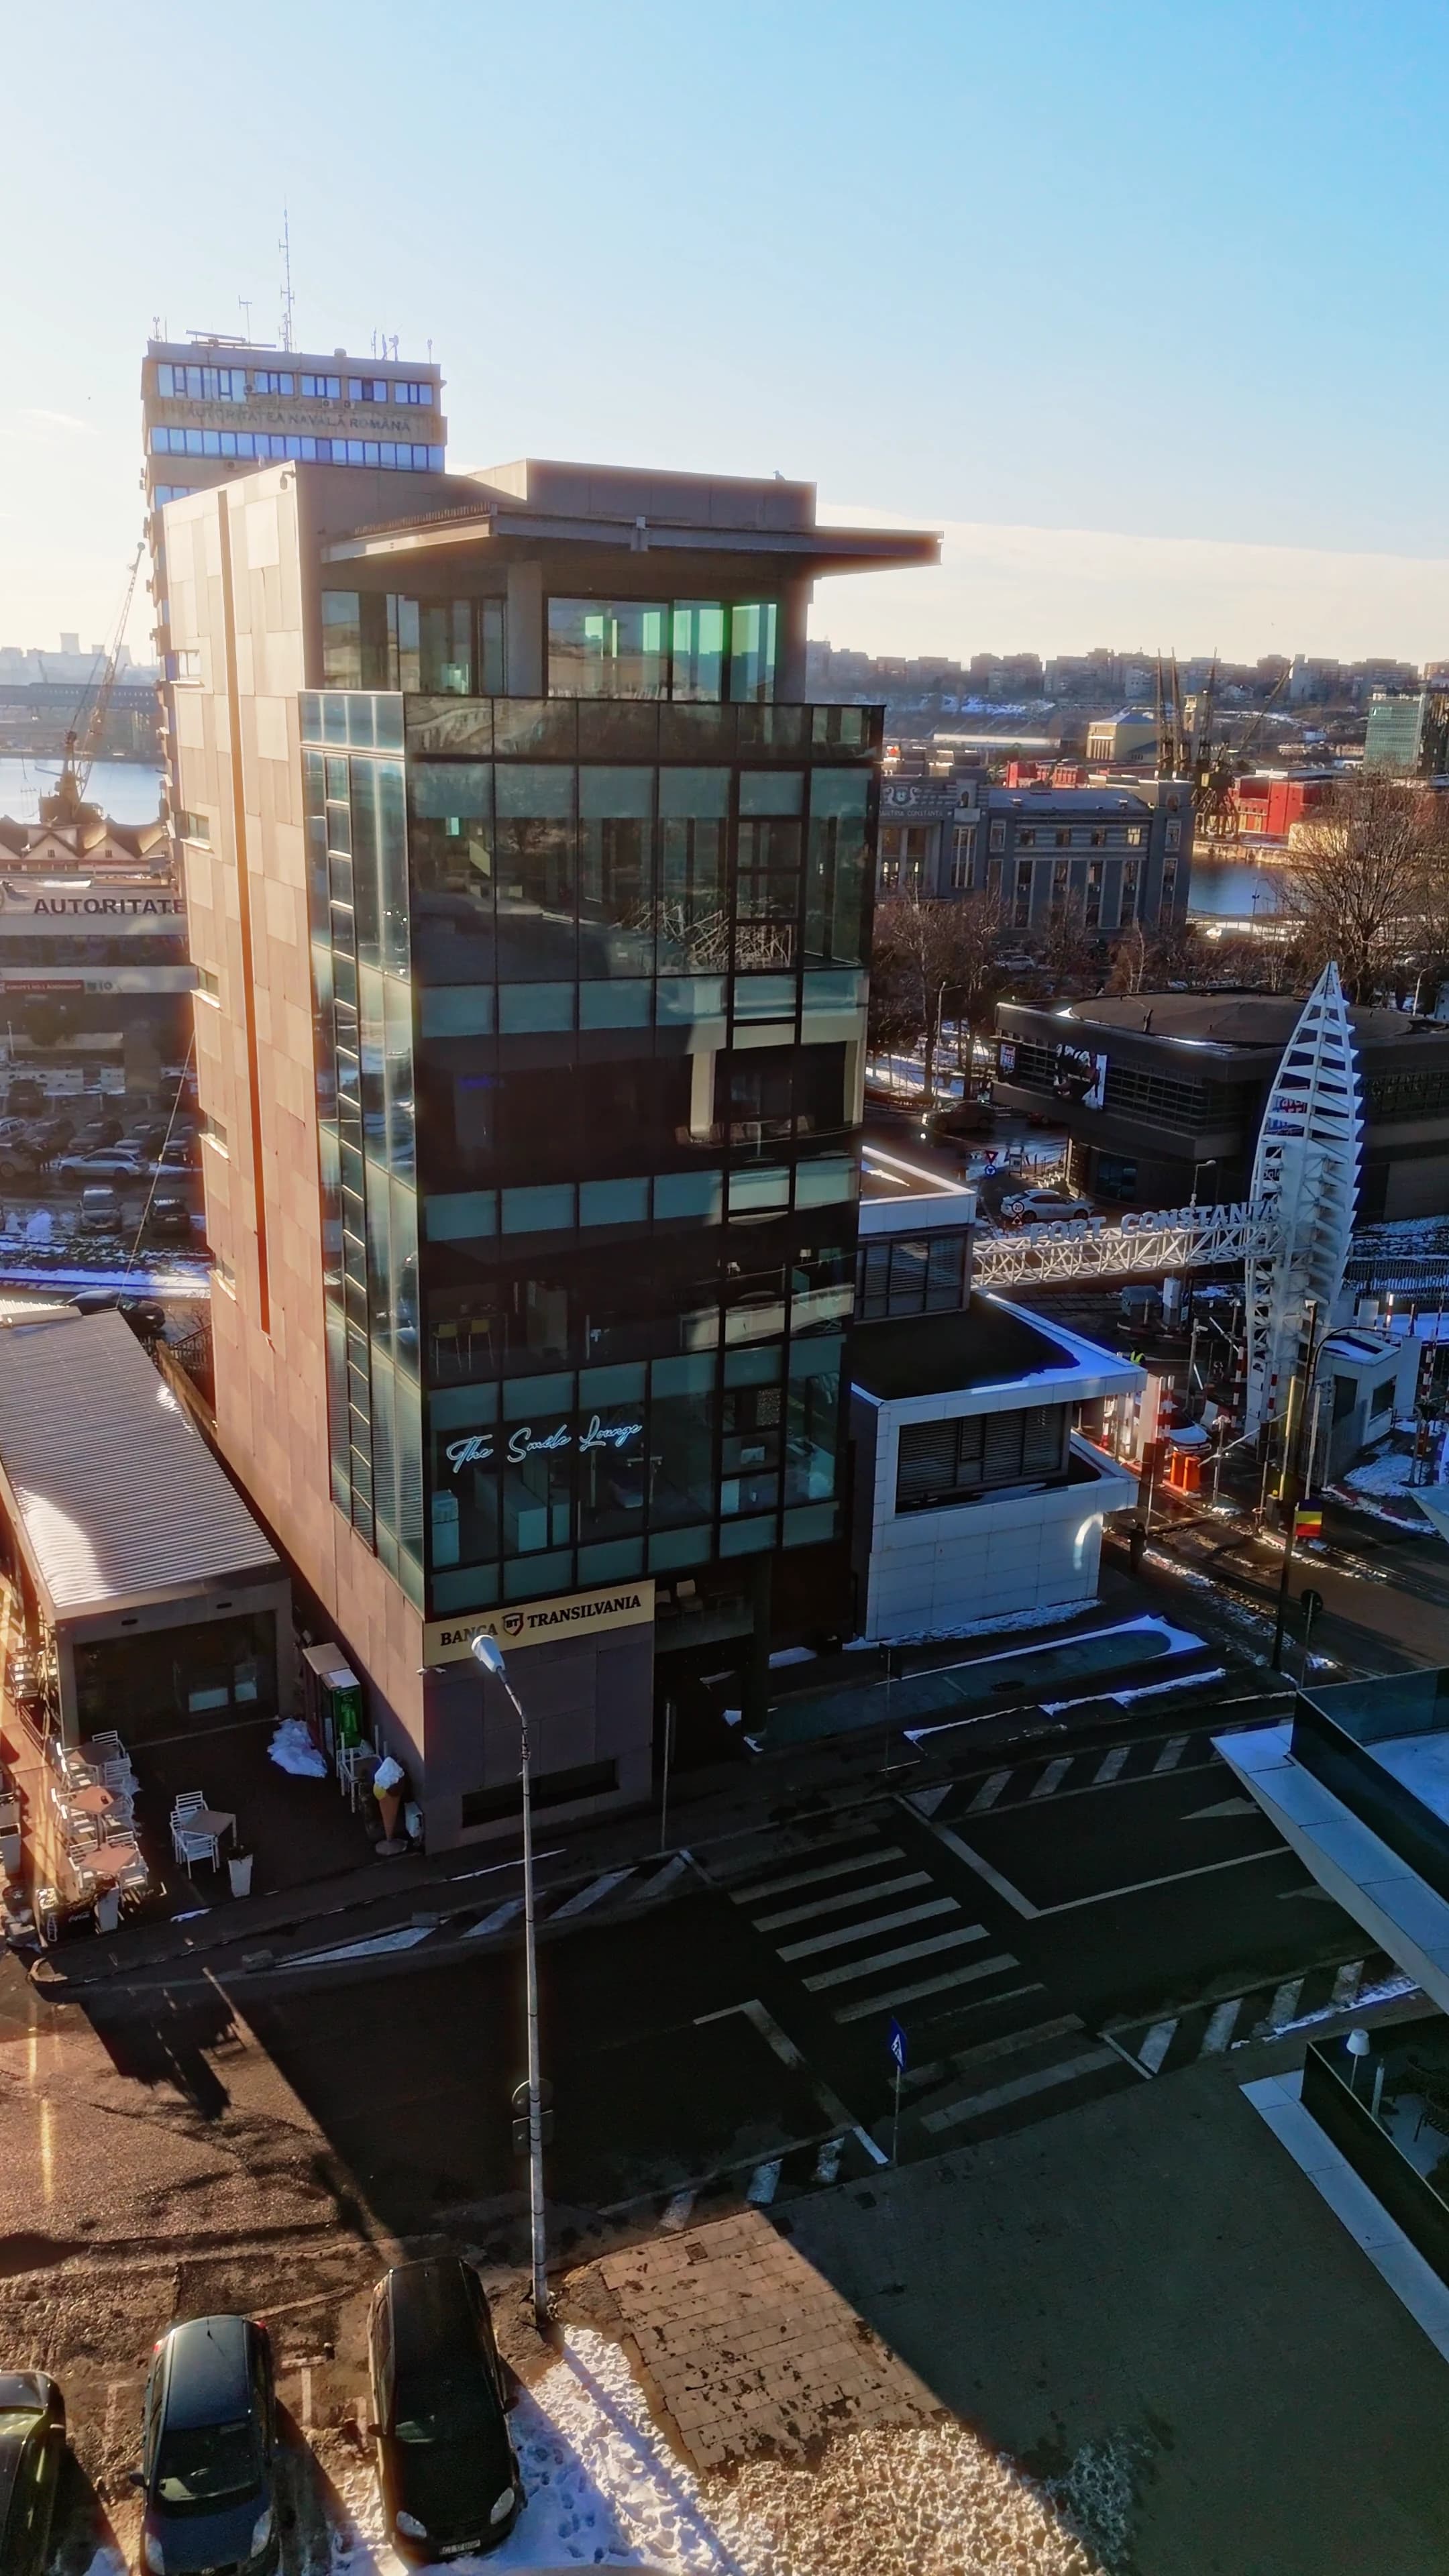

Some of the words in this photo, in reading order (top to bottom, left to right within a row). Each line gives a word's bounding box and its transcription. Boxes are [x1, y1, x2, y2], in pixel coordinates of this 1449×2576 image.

[1030, 1216, 1106, 1246] PORT
[1122, 1200, 1277, 1235] CONSTANTA
[446, 1434, 494, 1473] The
[506, 1424, 572, 1462] Smile
[579, 1415, 643, 1452] Lounge
[440, 1623, 498, 1646] BANCA
[527, 1595, 641, 1629] TRANSILVANIA
